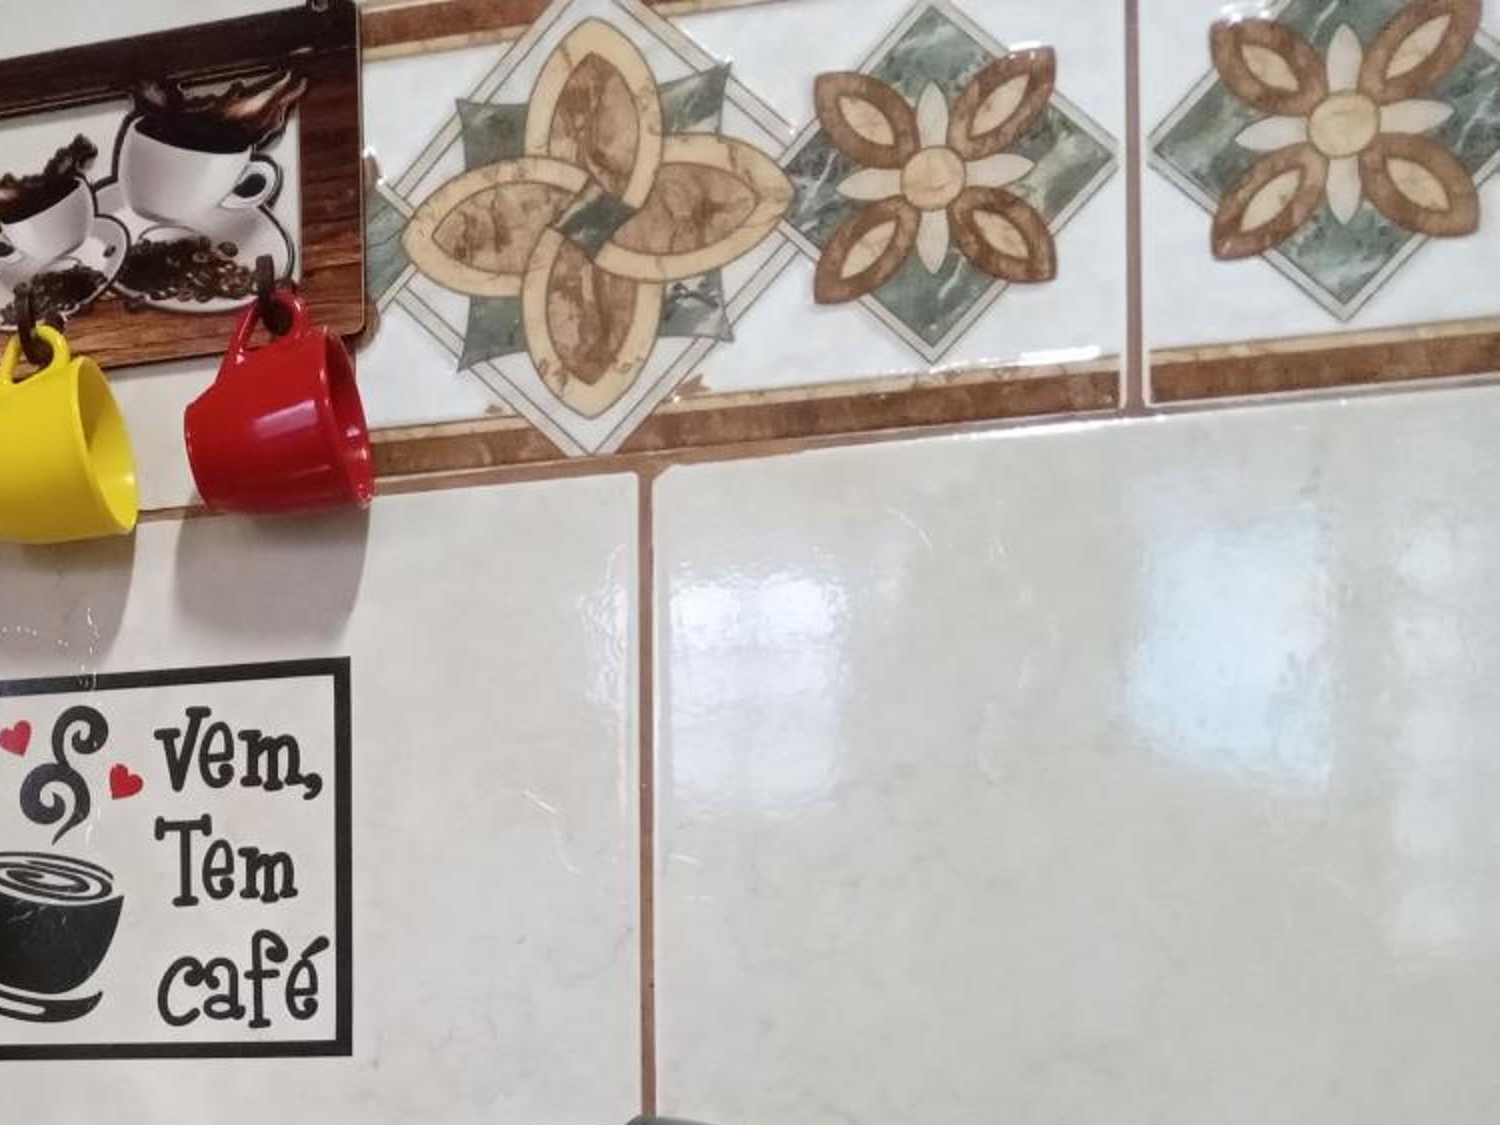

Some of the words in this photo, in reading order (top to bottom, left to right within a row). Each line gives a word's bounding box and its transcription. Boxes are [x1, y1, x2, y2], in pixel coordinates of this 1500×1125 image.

[153, 705, 323, 800] Vem,
[154, 813, 298, 907] Tem
[157, 929, 330, 1029] café
